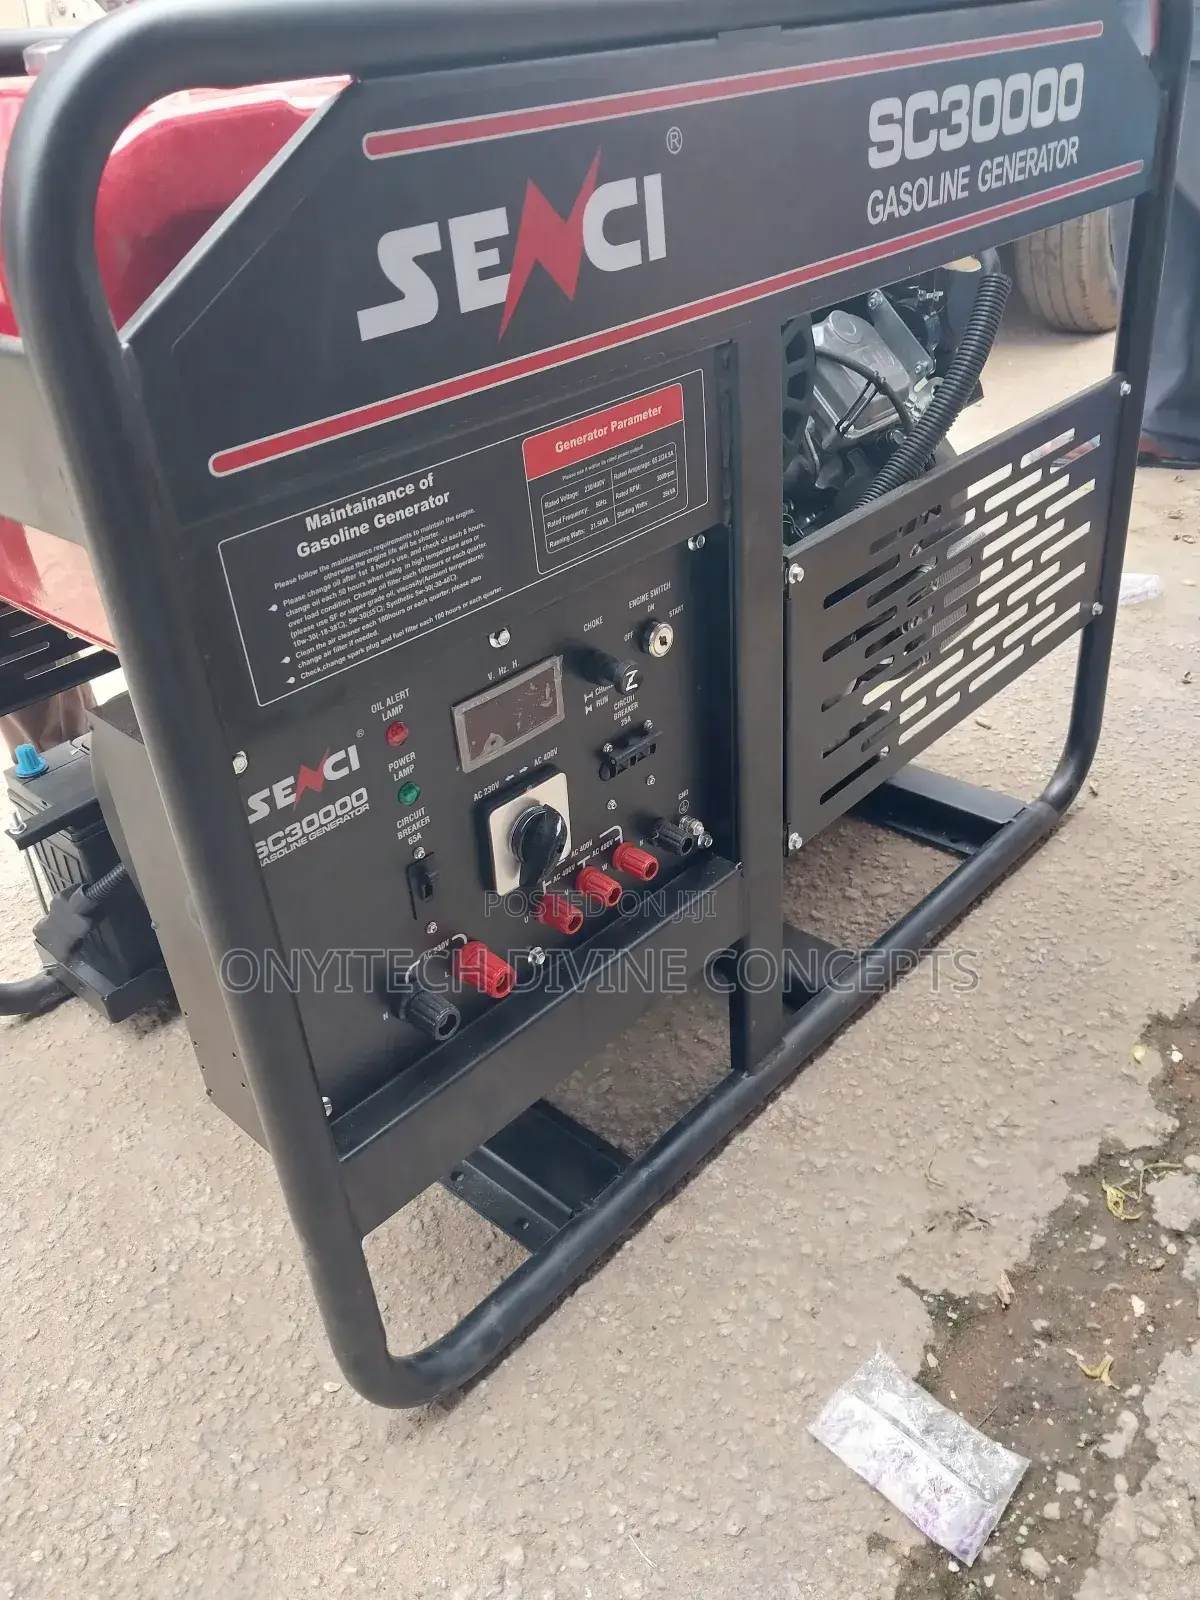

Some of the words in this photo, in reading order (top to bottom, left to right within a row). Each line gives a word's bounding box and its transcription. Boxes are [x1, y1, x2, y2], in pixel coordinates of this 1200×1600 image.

[868, 62, 1085, 169] SC30000
[866, 164, 971, 225] GASOLINE
[977, 135, 1080, 193] GENERATOR
[356, 145, 666, 344] SENCI
[555, 426, 608, 453] Generator
[611, 406, 662, 432] Parameter
[305, 483, 415, 532] Maintainance
[419, 472, 433, 490] of
[544, 498, 560, 509] Rated
[297, 523, 369, 557] Gasoline
[374, 491, 450, 528] Generator
[547, 517, 562, 529] Rated
[274, 577, 297, 590] Please
[298, 569, 318, 581] follow
[319, 564, 330, 572] the
[373, 533, 413, 552] requirements
[420, 520, 445, 533] maintain
[323, 565, 354, 581] otherwise
[355, 560, 366, 568] the
[366, 552, 387, 564] engine
[388, 547, 397, 555] life
[398, 542, 409, 551] will
[282, 594, 306, 607] Please
[307, 584, 331, 597] change
[332, 579, 341, 587] oil
[342, 574, 356, 584] after
[358, 568, 368, 577] 1st
[375, 558, 395, 570] hour's
[410, 546, 422, 557] and
[422, 540, 440, 551] check
[440, 536, 448, 544] oil
[449, 531, 463, 541] each
[285, 603, 310, 617] change
[311, 598, 321, 607] oil
[321, 592, 337, 603] each
[338, 587, 347, 596] 50
[347, 581, 366, 592] hours
[366, 574, 384, 584] when
[385, 566, 402, 577] using
[411, 557, 425, 566] high
[425, 543, 460, 561] temperature
[461, 538, 473, 546] area
[288, 617, 303, 628] over
[304, 610, 320, 621] load
[353, 587, 377, 601] Change
[378, 582, 387, 591] oil
[387, 577, 401, 587] filter
[402, 571, 417, 581] each
[452, 550, 466, 560] each
[386, 593, 414, 609] Synthetic
[628, 592, 650, 609] ENGINE
[649, 581, 671, 598] SWITCH
[290, 624, 315, 639] (please
[316, 619, 328, 627] use
[329, 613, 338, 622] SF
[347, 602, 366, 614] upper
[367, 595, 385, 608] grade
[295, 647, 315, 659] Clean
[315, 642, 327, 650] the
[327, 637, 336, 645] air
[337, 627, 361, 641] cleaner
[361, 620, 377, 630] each
[414, 598, 428, 608] each
[451, 581, 469, 593] please
[470, 575, 482, 584] also
[647, 603, 655, 612] ON
[669, 604, 684, 618] START
[347, 648, 365, 659] spark
[365, 641, 380, 652] plug
[380, 634, 392, 645] and
[392, 629, 405, 639] fuel
[405, 624, 418, 633] filter
[419, 617, 434, 627] each
[434, 611, 445, 620] 100
[445, 605, 462, 616] hours
[469, 596, 483, 605] each
[583, 615, 604, 632] CHOKE
[623, 631, 634, 642] OFF
[298, 654, 322, 669] change
[323, 650, 332, 658] air
[333, 643, 348, 653] filter
[370, 702, 385, 714] OIL
[386, 687, 410, 708] ALERT
[596, 695, 609, 708] RUN
[613, 694, 635, 711] CIRCUIT
[613, 701, 639, 721] BREAKER
[381, 704, 404, 722] LAMP
[620, 715, 632, 727] 25A
[388, 751, 417, 773] POWER
[533, 756, 543, 767] AC
[543, 747, 558, 761] 400V
[247, 744, 361, 825] SENCI
[393, 764, 415, 782] LAMP
[473, 790, 484, 802] AC
[484, 780, 500, 796] 230V
[308, 802, 370, 841] GENERATOR
[396, 806, 426, 829] CIRCUIT
[397, 815, 431, 841] BREAKER
[407, 832, 423, 846] 65A
[570, 848, 579, 858] AC
[433, 938, 451, 955] 230V
